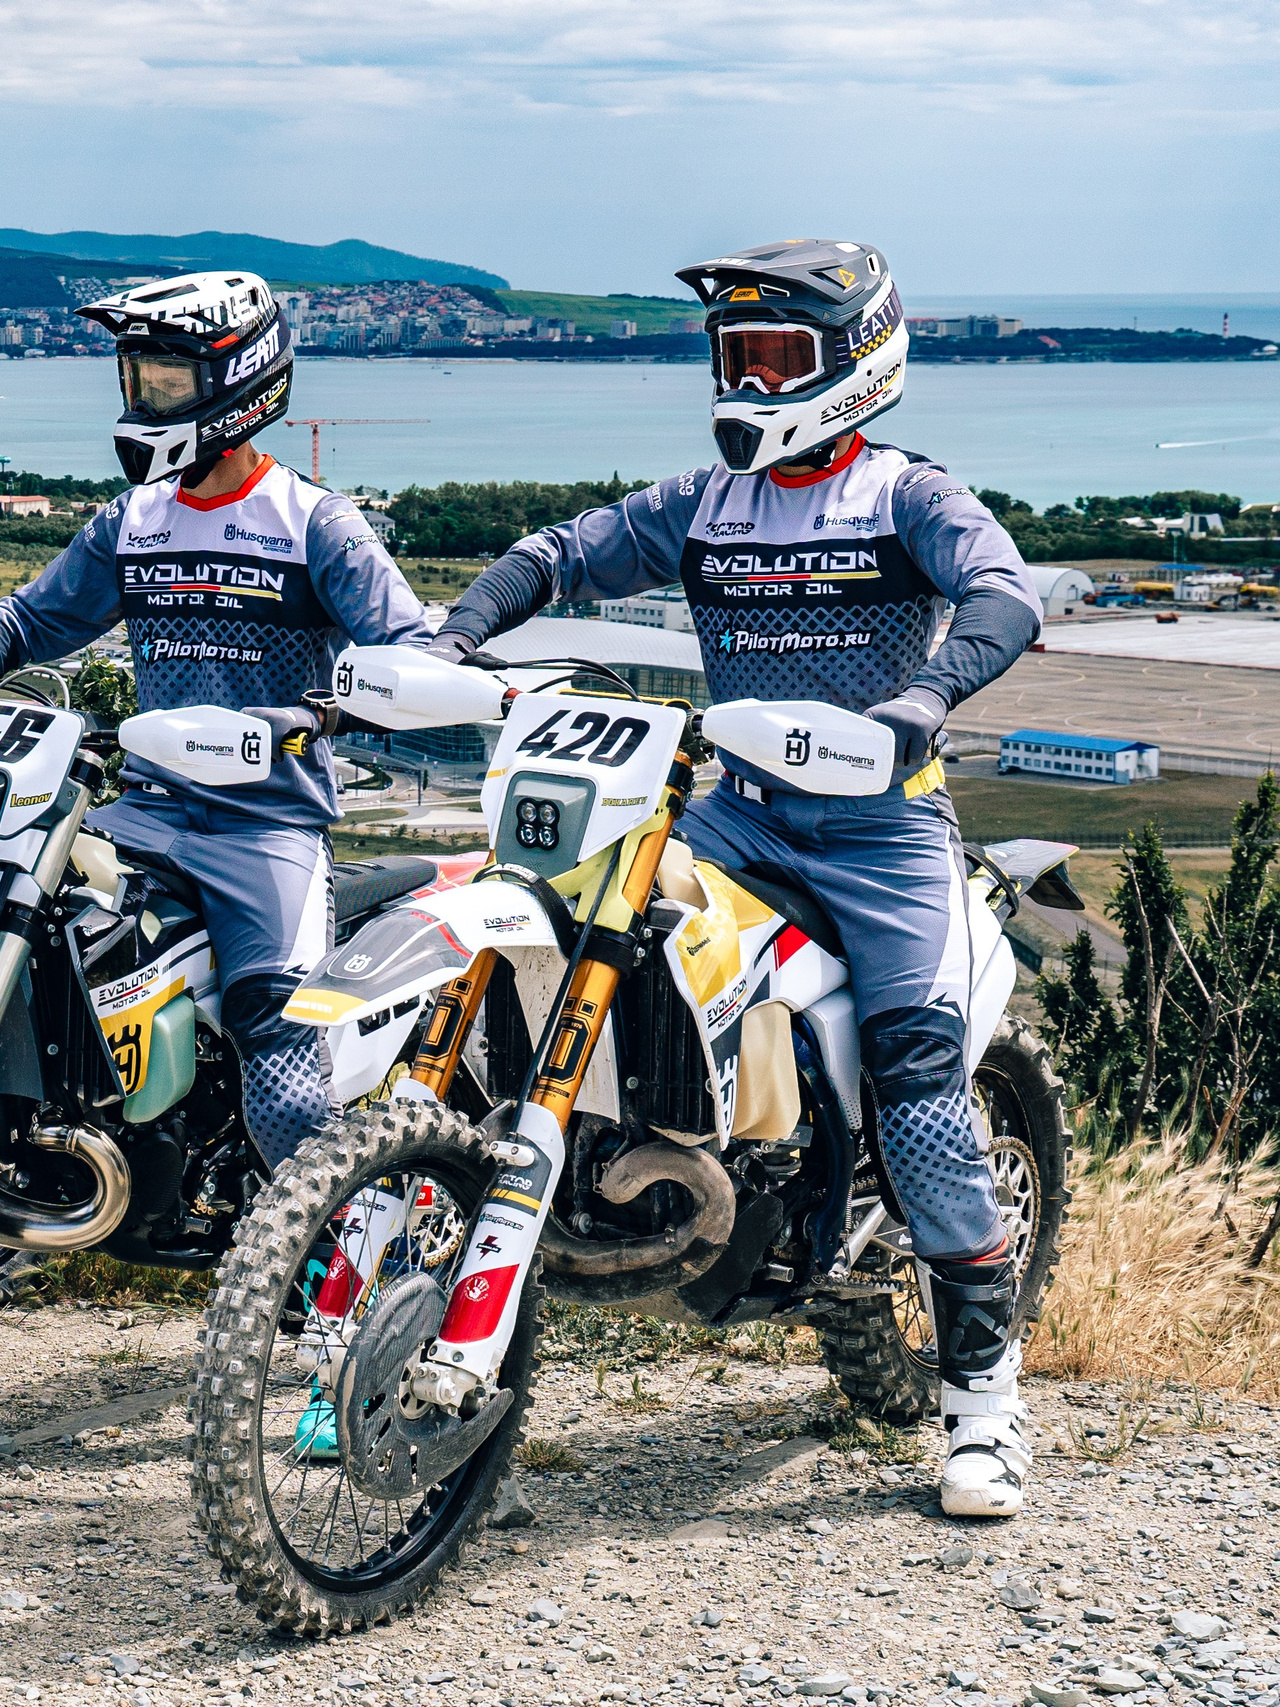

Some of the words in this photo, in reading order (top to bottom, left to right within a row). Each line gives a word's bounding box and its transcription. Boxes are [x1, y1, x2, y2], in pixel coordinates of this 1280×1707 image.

[847, 298, 894, 350] LEATT
[224, 321, 280, 385] LEATT
[820, 358, 902, 419] EVOLUTION
[201, 373, 287, 437] EVOLUTION
[844, 399, 878, 423] MOTOR
[882, 388, 893, 400] OIL
[225, 415, 263, 439] MOTOR
[266, 402, 279, 413] OIL
[236, 527, 293, 547] Husqvarna
[701, 550, 878, 573] EVOLUTION
[125, 564, 284, 591] EVOLUTION
[723, 584, 793, 596] MOTOR
[805, 583, 842, 595] OIL
[148, 594, 205, 606] MOTOR
[215, 595, 243, 609] OIL
[365, 683, 393, 697] Husqvarna
[196, 743, 234, 753] Husqvarna
[515, 709, 650, 768] 420
[829, 750, 875, 766] Husqvarna
[10, 792, 52, 808] Leonov
[484, 915, 530, 926] EVOLUTION
[99, 964, 159, 1001] EVOLUTION
[112, 994, 138, 1010] MOTOR
[140, 988, 150, 998] OIL
[707, 975, 748, 1022] EVOLUTION
[717, 1012, 735, 1029] MOTOR
